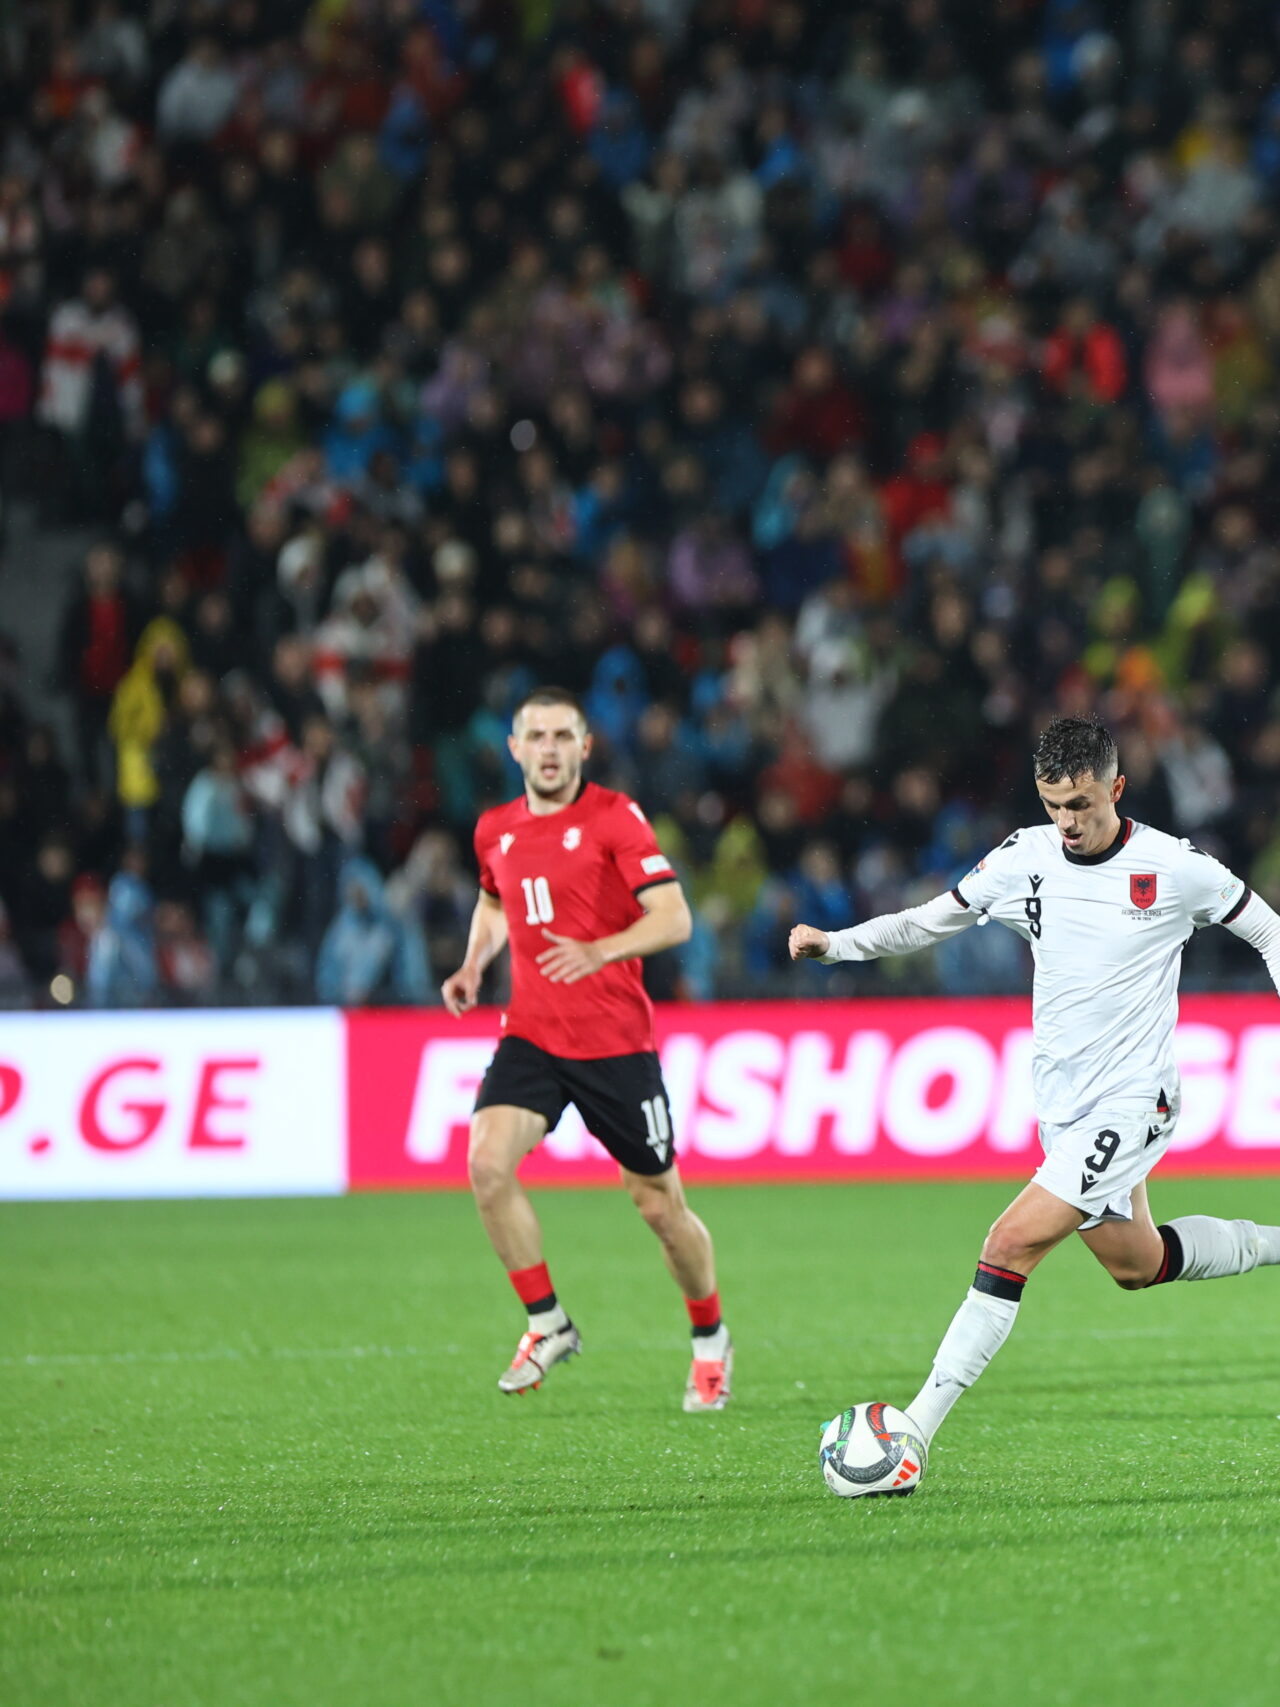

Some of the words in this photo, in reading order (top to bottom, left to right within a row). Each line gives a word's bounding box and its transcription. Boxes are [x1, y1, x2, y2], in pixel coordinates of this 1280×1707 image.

[521, 876, 554, 925] 10
[1025, 897, 1042, 939] 9
[641, 1094, 670, 1147] 10
[1084, 1128, 1121, 1173] 9
